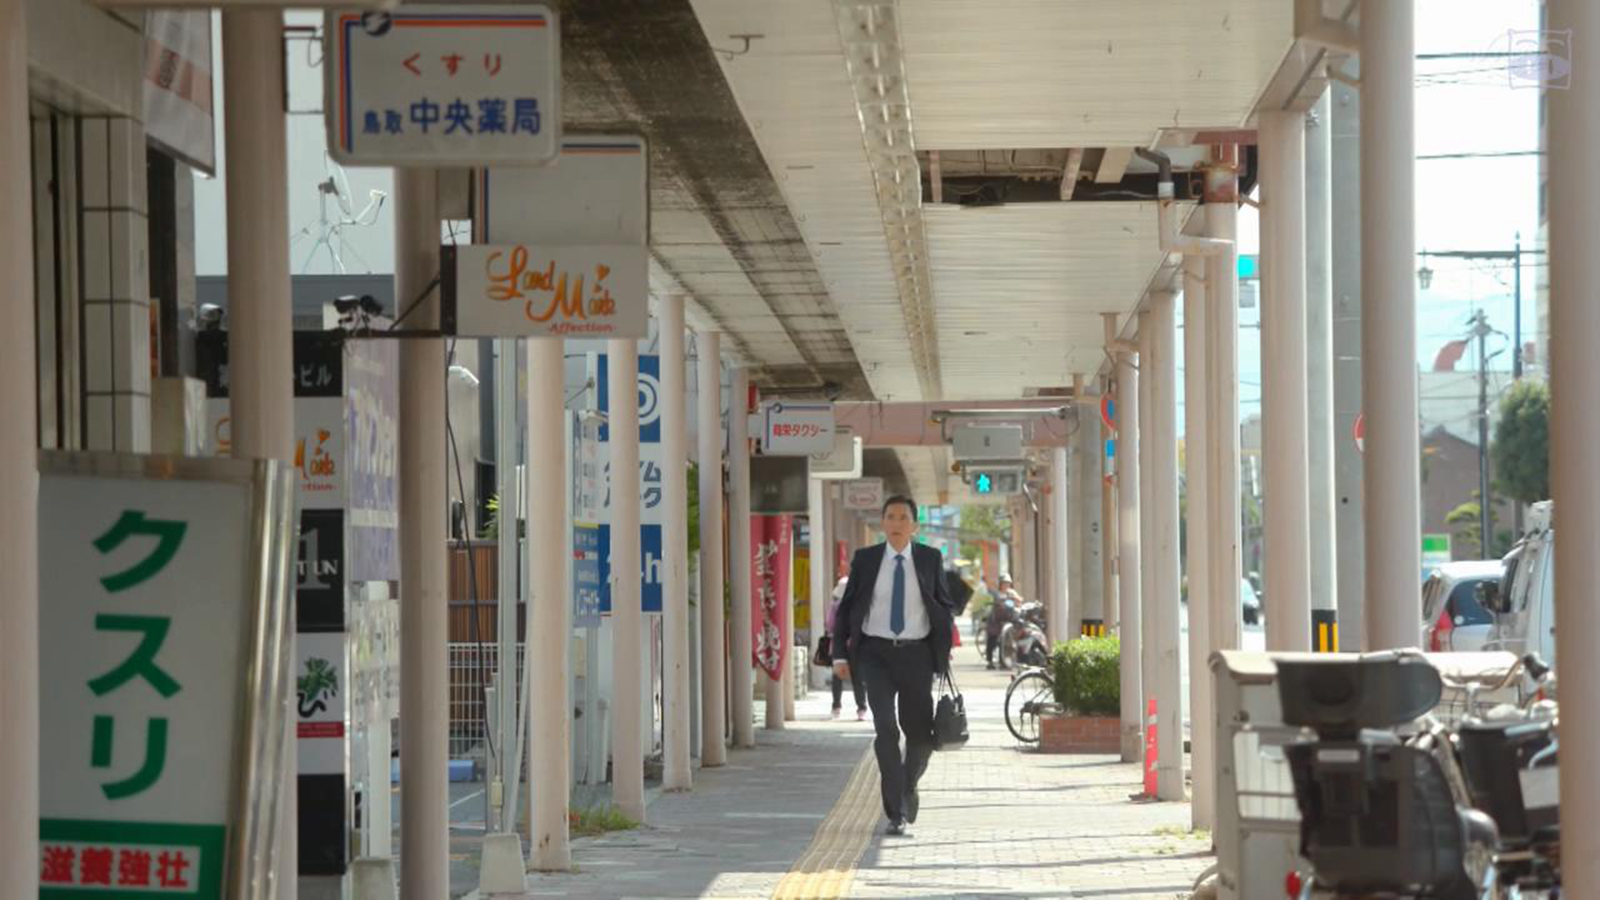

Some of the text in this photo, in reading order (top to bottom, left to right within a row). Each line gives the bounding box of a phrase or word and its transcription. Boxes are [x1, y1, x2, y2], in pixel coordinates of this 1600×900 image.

[402, 53, 502, 76] くすり
[86, 508, 189, 800] クスリ
[40, 844, 190, 888] 滋養強壮
